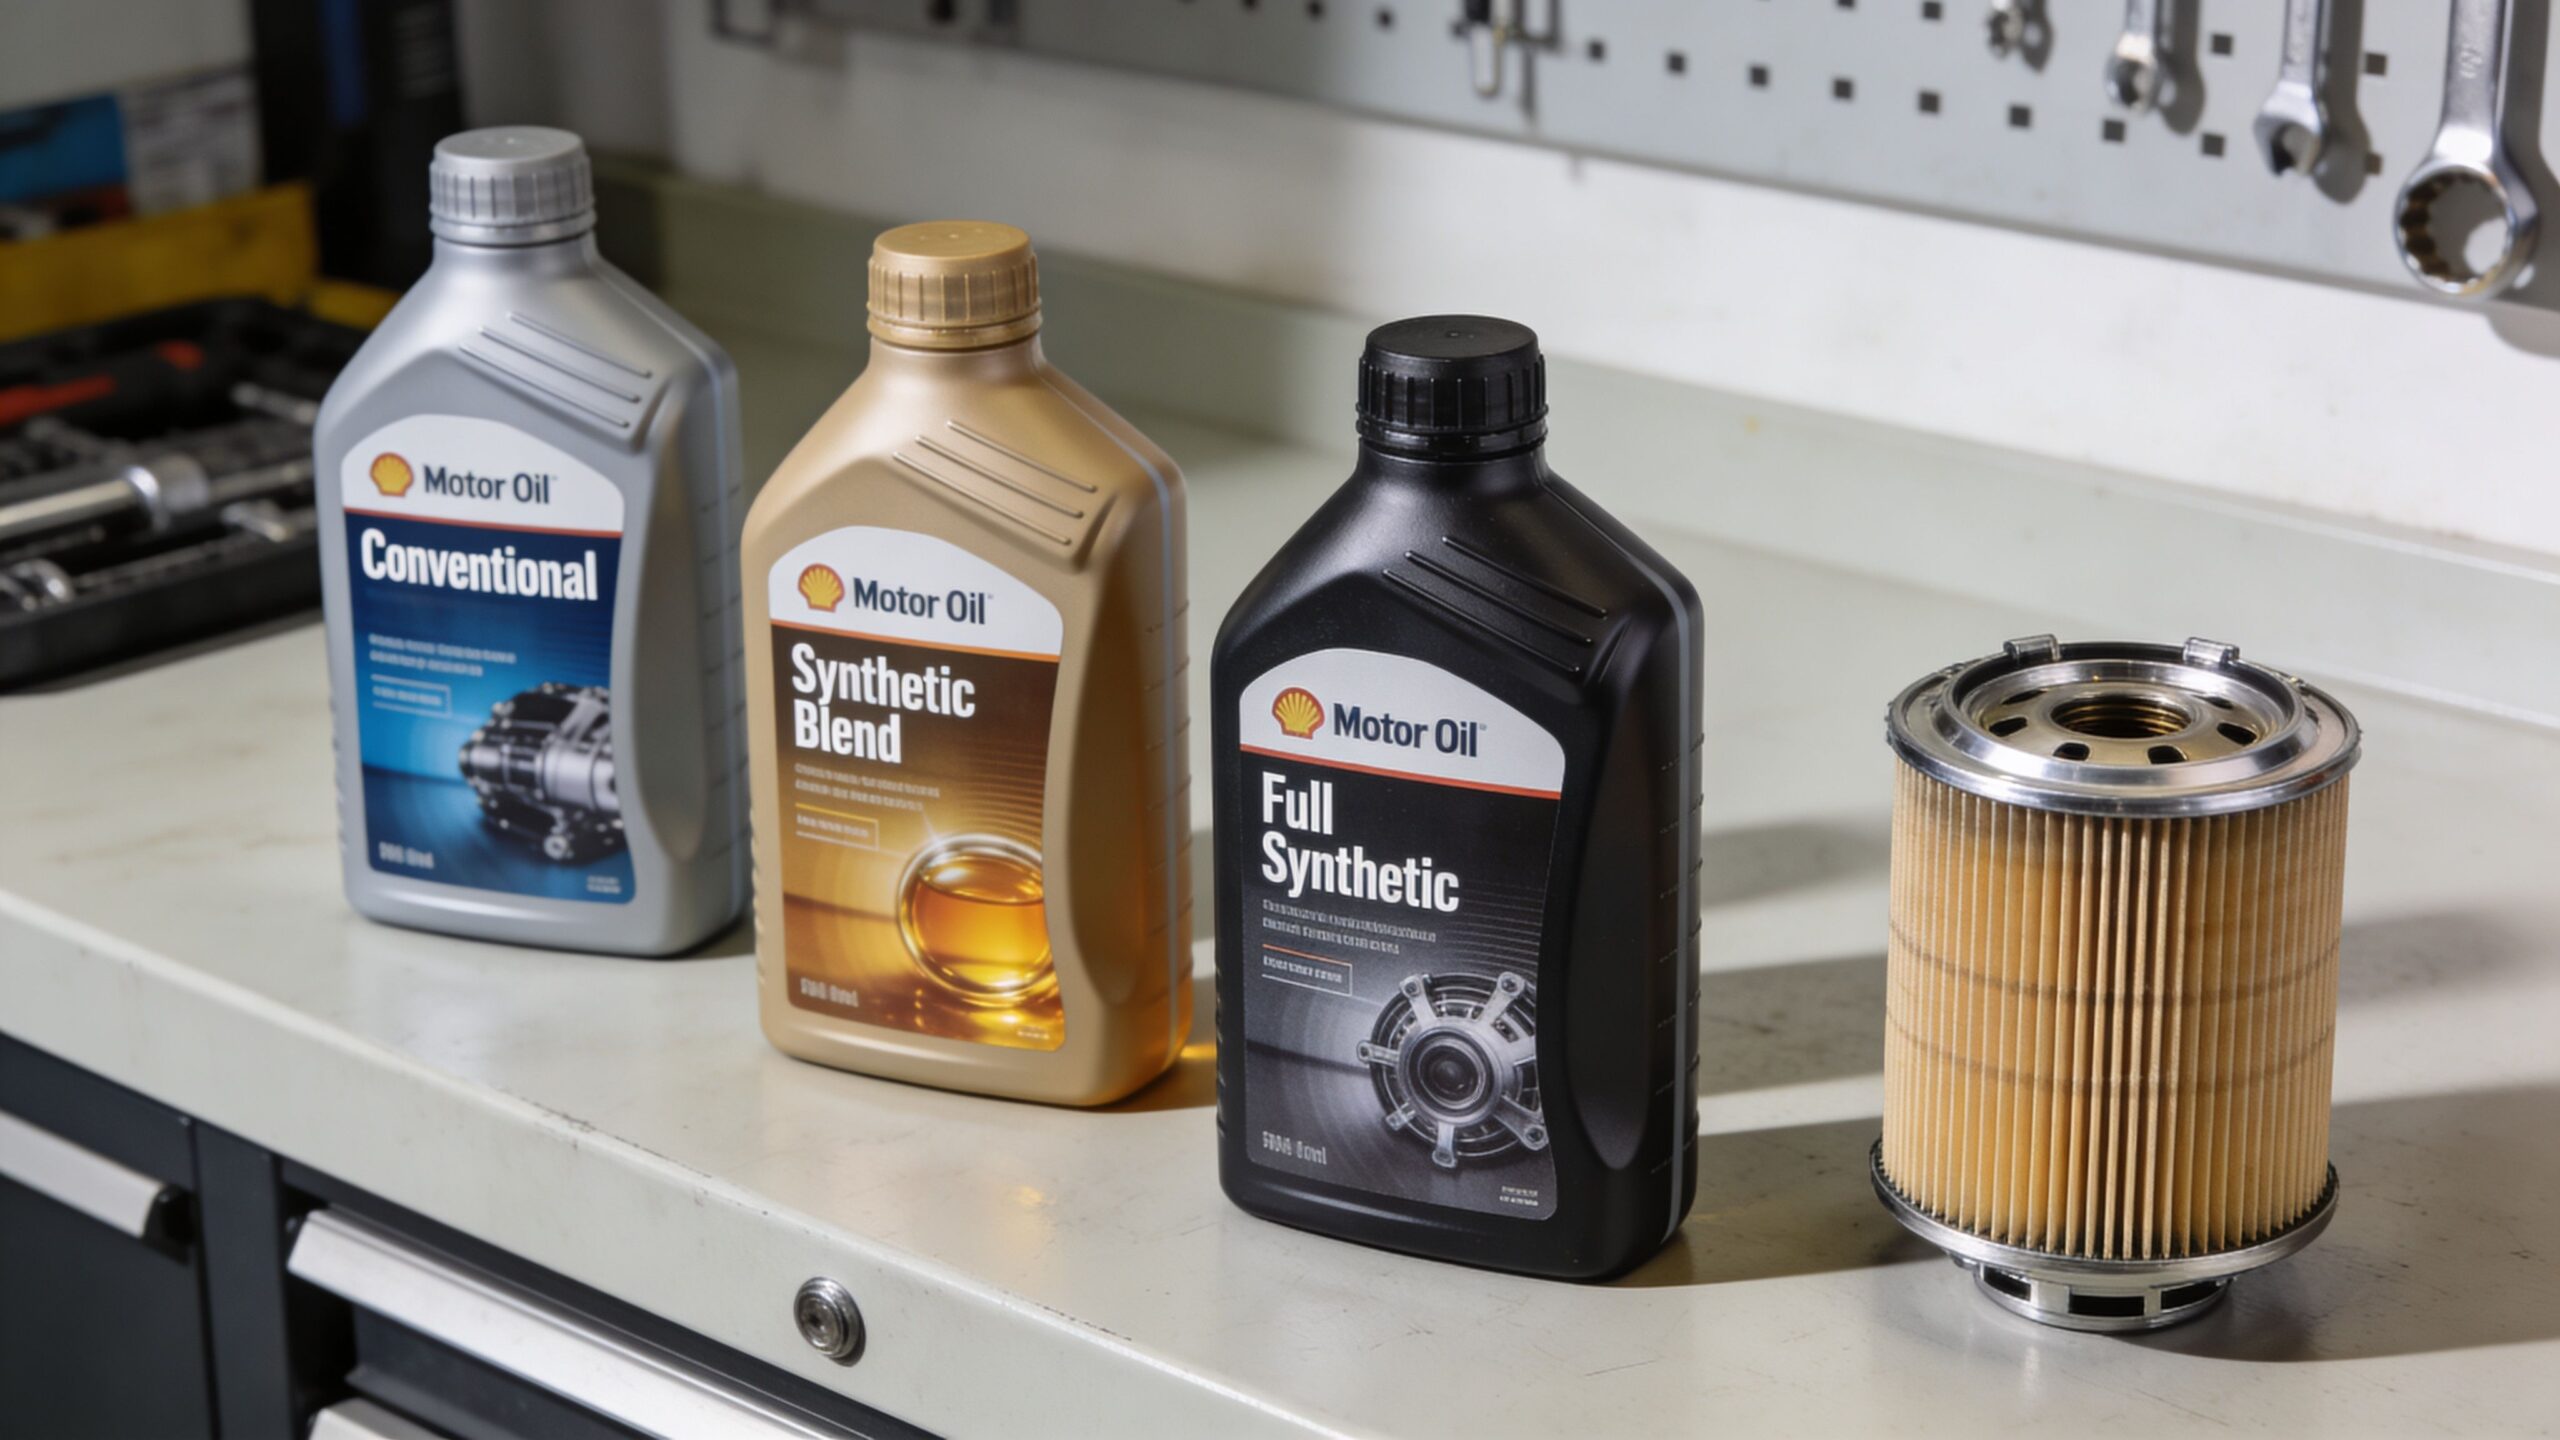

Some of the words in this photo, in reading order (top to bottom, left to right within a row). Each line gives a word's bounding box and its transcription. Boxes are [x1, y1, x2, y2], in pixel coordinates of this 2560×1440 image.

[422, 464, 505, 500] Motor
[361, 528, 599, 601] Conventional
[853, 576, 940, 618] Motor
[792, 642, 976, 718] Synthetic
[794, 698, 902, 763] Blend
[1334, 703, 1428, 748] Motor
[1262, 771, 1333, 835] Full
[1262, 831, 1460, 912] Synthetic
